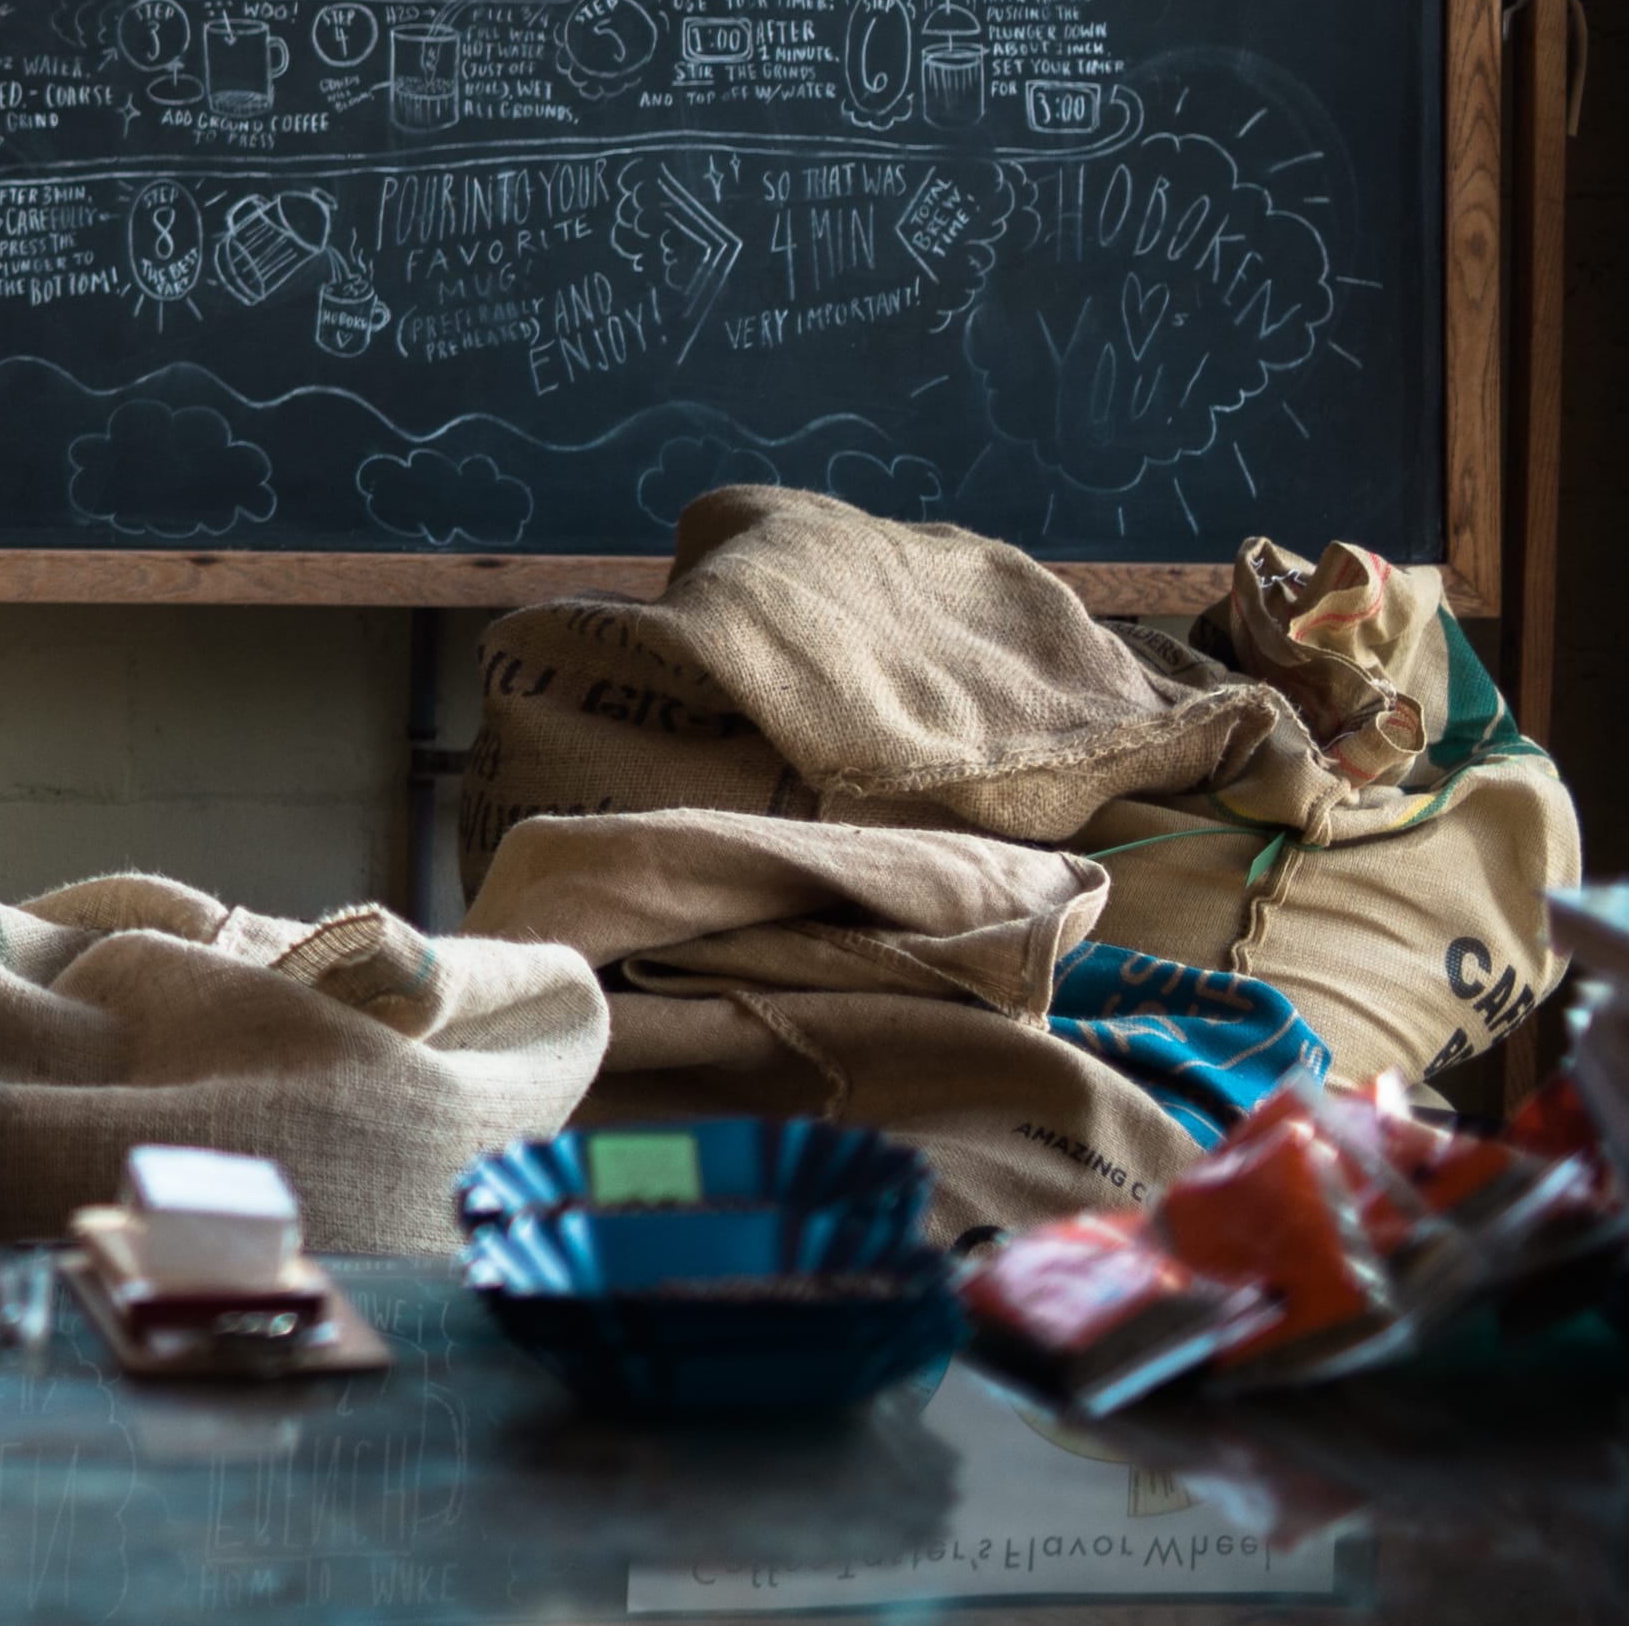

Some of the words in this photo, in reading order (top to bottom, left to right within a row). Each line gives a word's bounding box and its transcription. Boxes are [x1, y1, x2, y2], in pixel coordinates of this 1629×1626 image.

[134, 3, 175, 20] STEP
[242, 2, 300, 21] WOO!
[1055, 5, 1082, 21] THE
[593, 17, 627, 64] 5
[692, 27, 742, 53] 1:00
[755, 18, 816, 46] AFTER
[987, 24, 1058, 42] PLUNGER
[1062, 21, 1109, 39] DOWN
[461, 43, 493, 60] HOT
[497, 43, 545, 60] WATER
[774, 45, 842, 64] MINUTE.
[860, 16, 890, 94] 6
[992, 41, 1050, 57] ABOUT
[508, 63, 535, 77] OFF
[673, 61, 715, 82] STIR
[724, 63, 757, 81] THE
[761, 64, 817, 81] GRINDS
[991, 59, 1024, 76] SET
[1030, 58, 1073, 75] YOUR
[1076, 58, 1127, 74] TIMER
[45, 82, 115, 109] COARSE
[517, 79, 554, 99] WET
[639, 90, 675, 109] AND
[686, 91, 716, 107] TOP
[754, 82, 838, 105] W/WATER
[991, 80, 1019, 97] FOR
[1036, 91, 1086, 125] 3:00
[7, 111, 60, 131] GRIND
[160, 110, 193, 127] ADD
[197, 111, 264, 132] GROUND
[270, 112, 330, 135] COFFEE
[762, 170, 791, 203] SO
[803, 162, 856, 200] THAT
[863, 164, 907, 197] WAS
[144, 187, 181, 210] STEP
[376, 171, 457, 251] POUR
[461, 168, 533, 235] INTO
[539, 157, 610, 219] YOUR
[5, 207, 99, 237] CAREFULLY
[152, 205, 176, 261] 8
[49, 231, 79, 252] THE
[406, 212, 593, 283] FAVORITE
[771, 208, 798, 302] 4
[810, 202, 876, 291] MIN
[29, 265, 123, 308] BOTTOM!
[554, 270, 613, 335] AND
[725, 308, 789, 350] VERY
[796, 275, 922, 335] IMPORTANT!
[529, 286, 669, 396] ENJOY!
[1010, 1121, 1129, 1191] AMAZING
